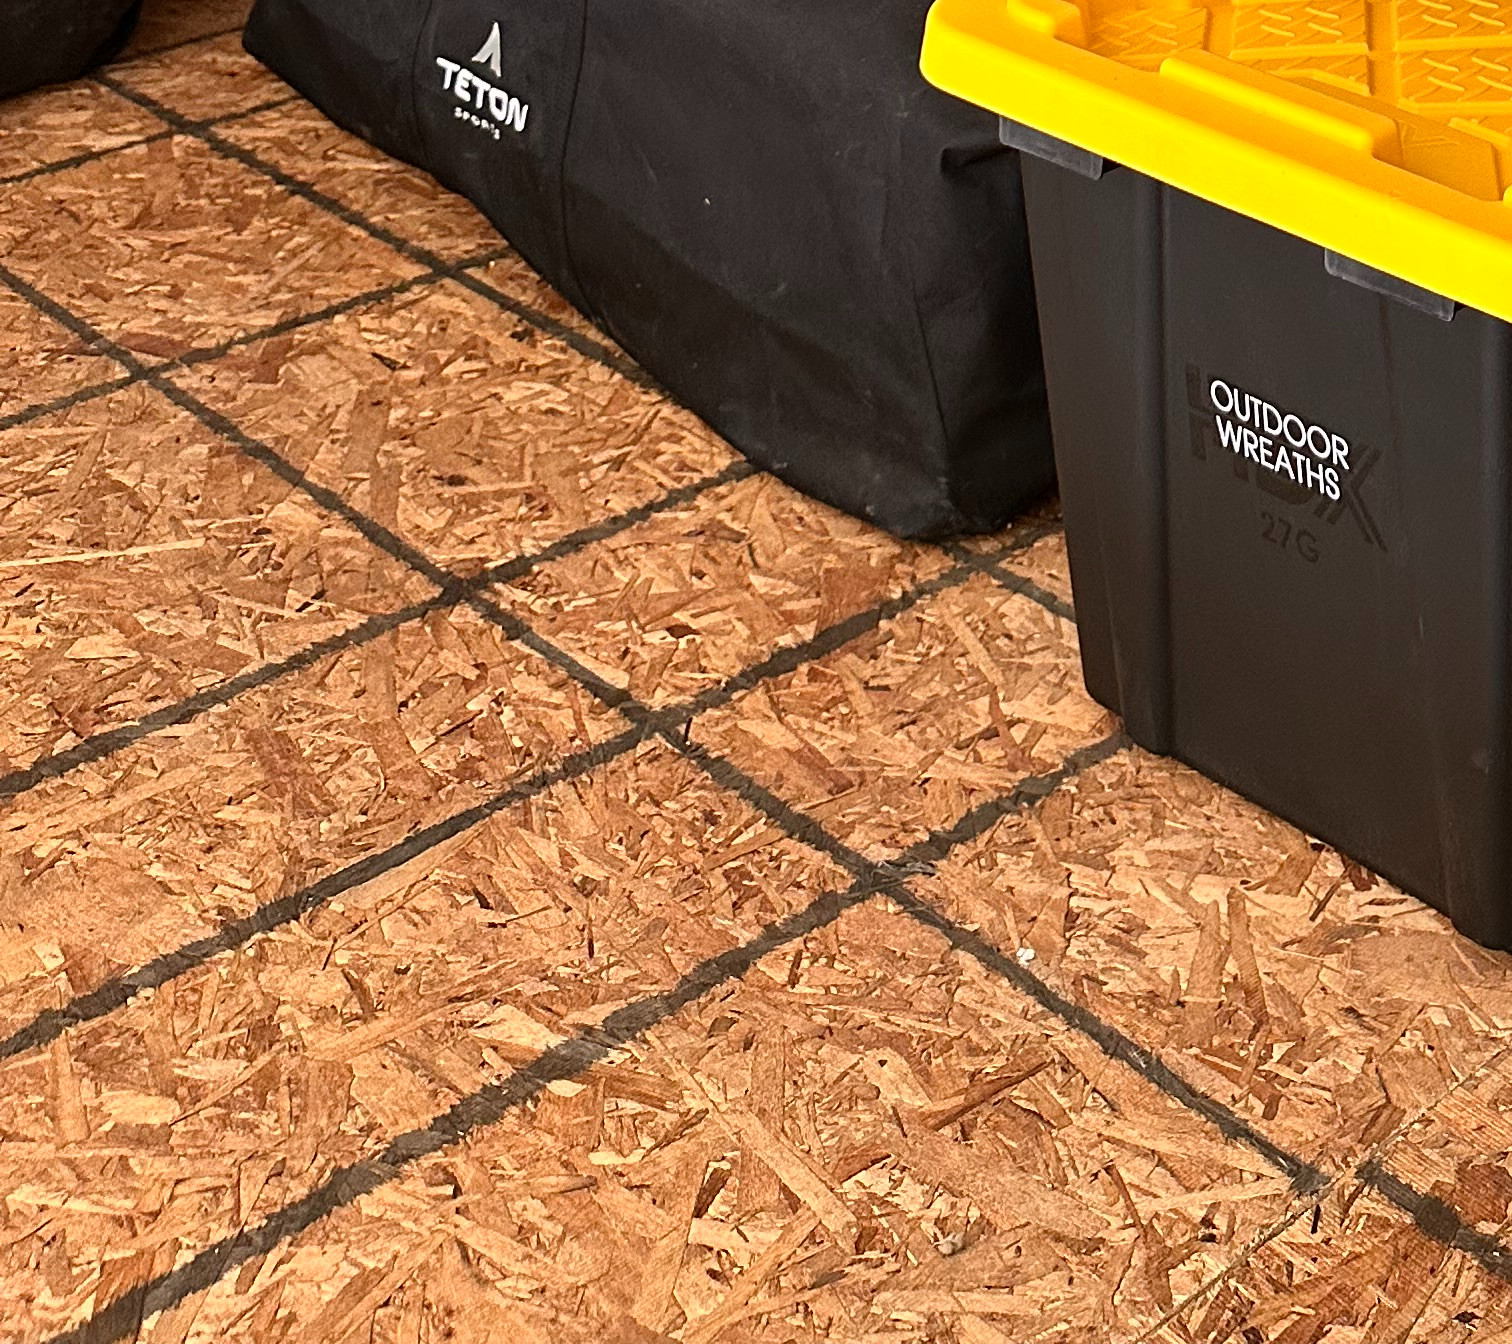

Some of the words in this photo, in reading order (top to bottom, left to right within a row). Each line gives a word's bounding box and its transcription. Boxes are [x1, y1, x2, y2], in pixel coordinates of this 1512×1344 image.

[435, 56, 529, 132] TETON
[1210, 379, 1350, 471] OUTDOOR
[1215, 414, 1341, 501] WREATHS
